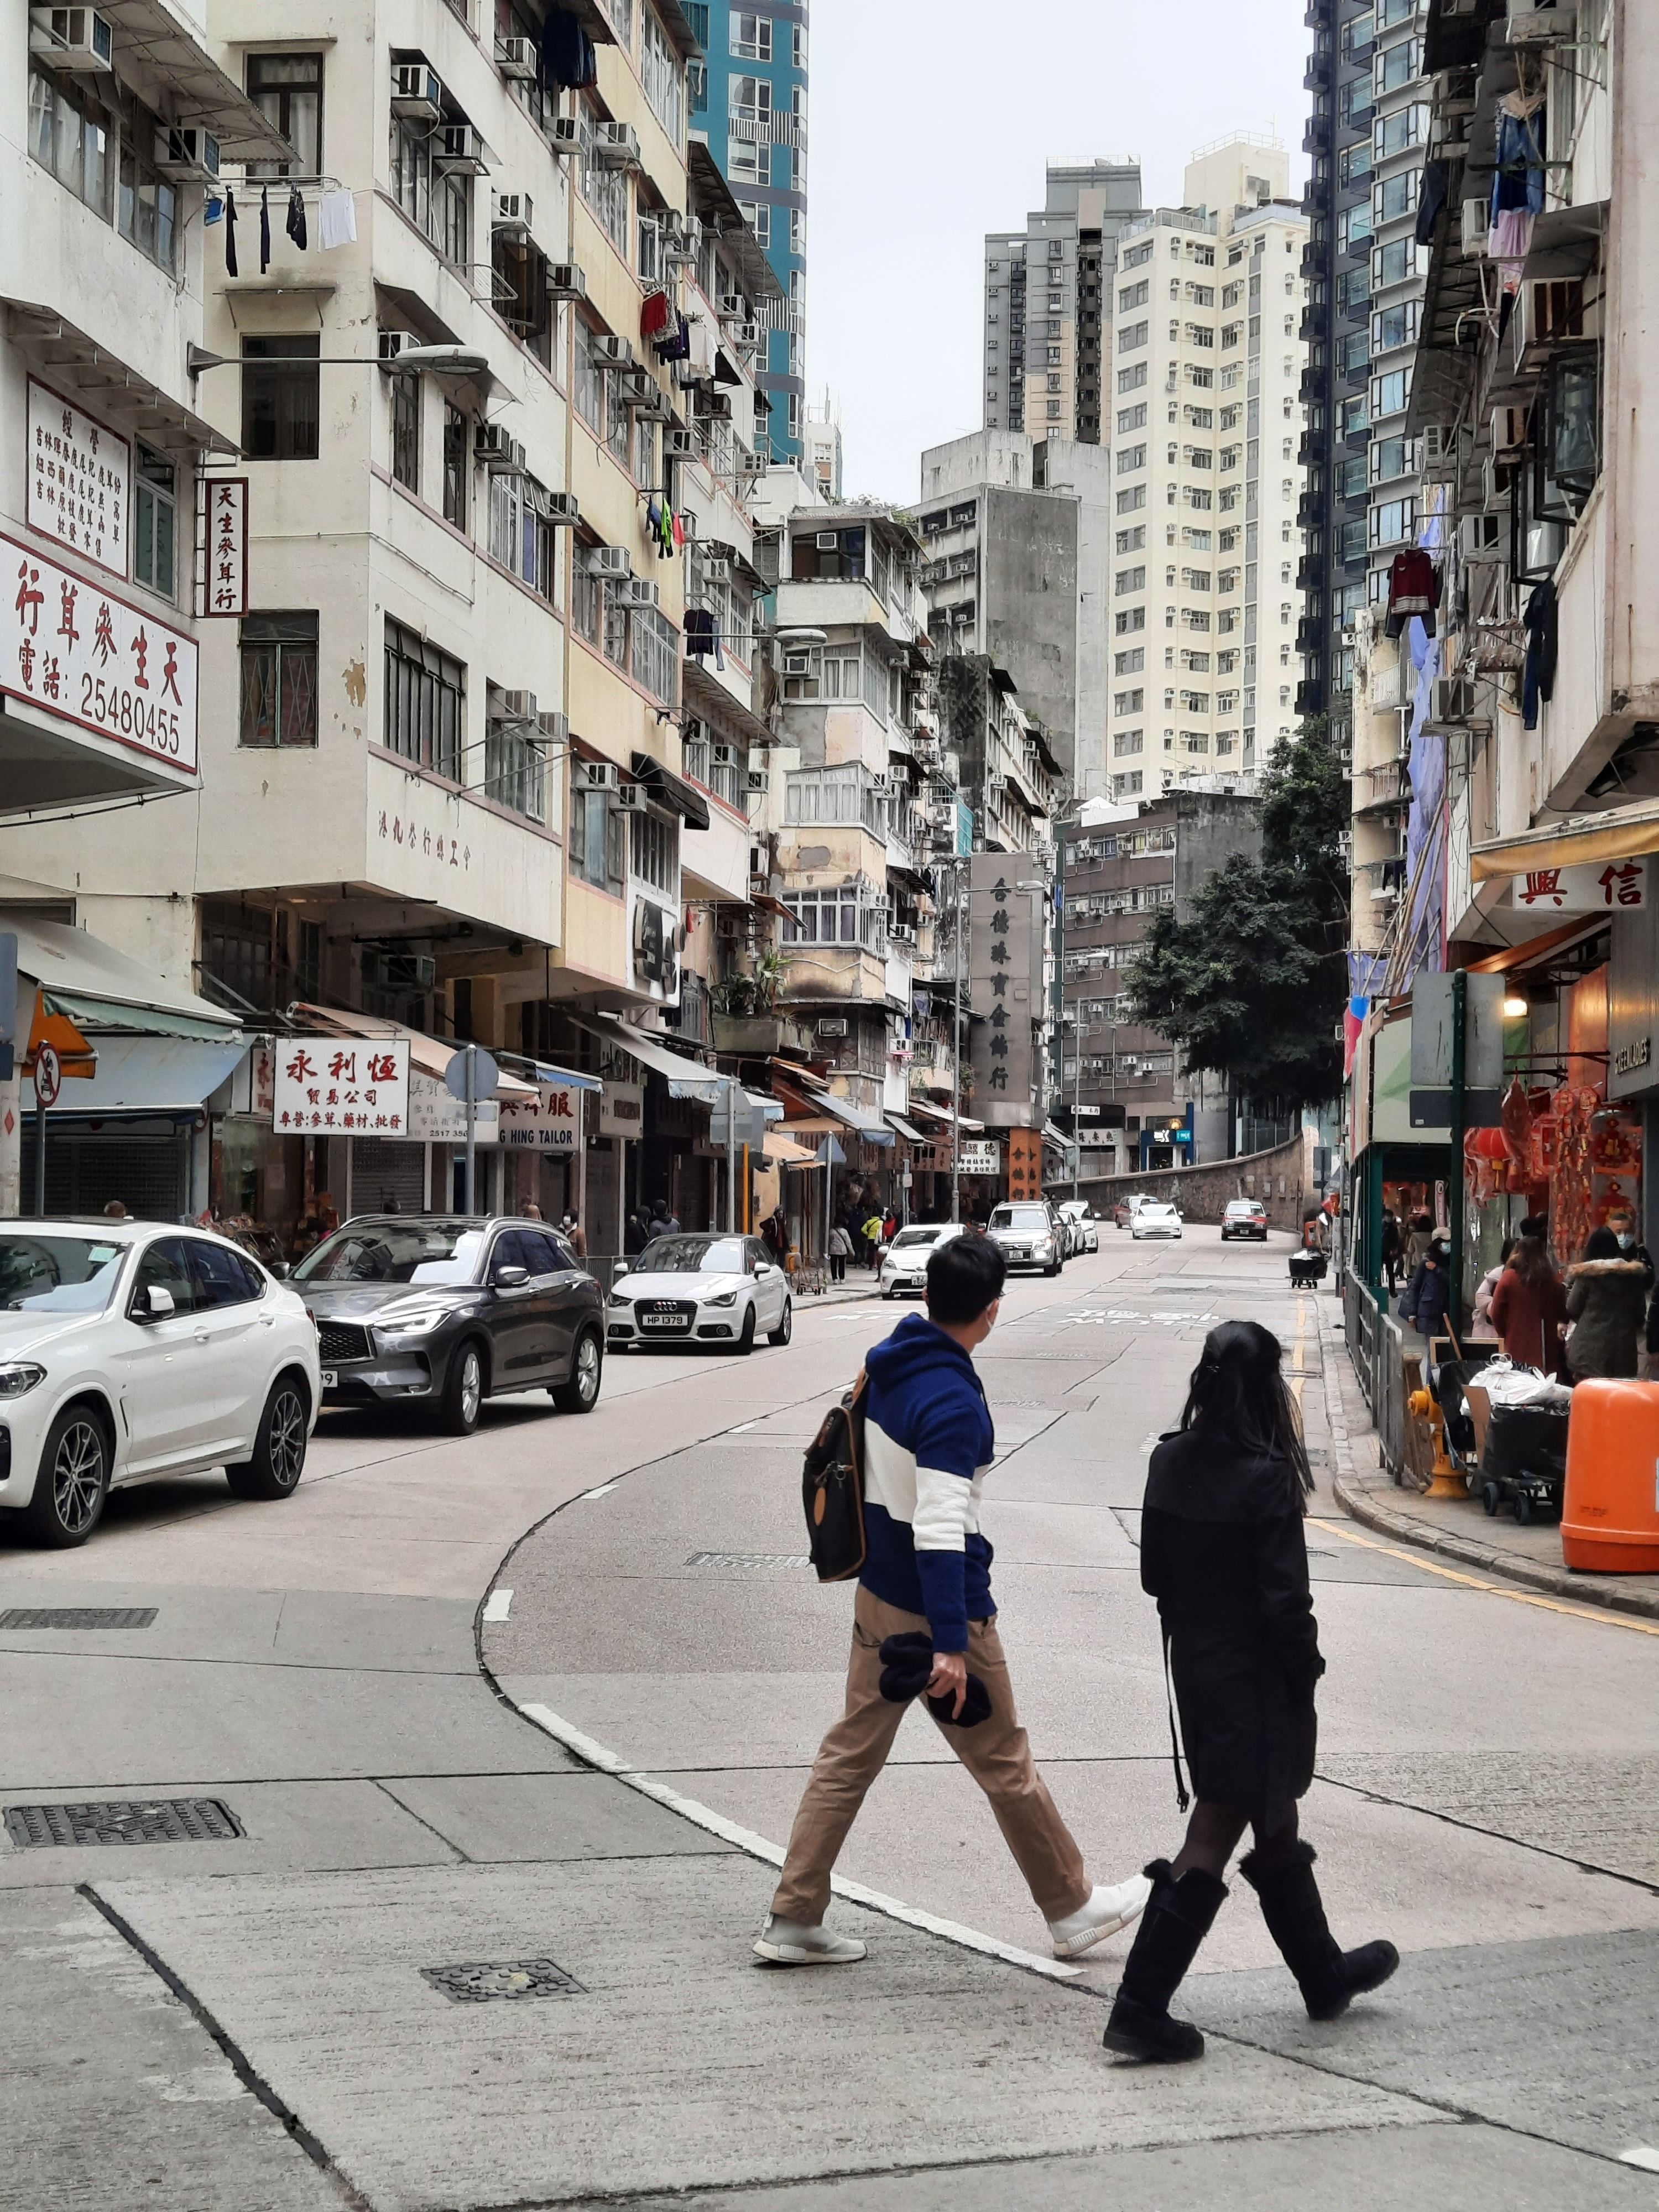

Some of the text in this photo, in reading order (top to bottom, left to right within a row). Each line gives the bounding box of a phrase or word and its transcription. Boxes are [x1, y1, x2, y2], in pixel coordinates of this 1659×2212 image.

[215, 487, 237, 609] 天生參茸行
[81, 672, 179, 754] 25480455
[306, 1088, 377, 1106] 貿易公司
[511, 1129, 534, 1144] HING
[539, 1130, 573, 1144] TAILOR
